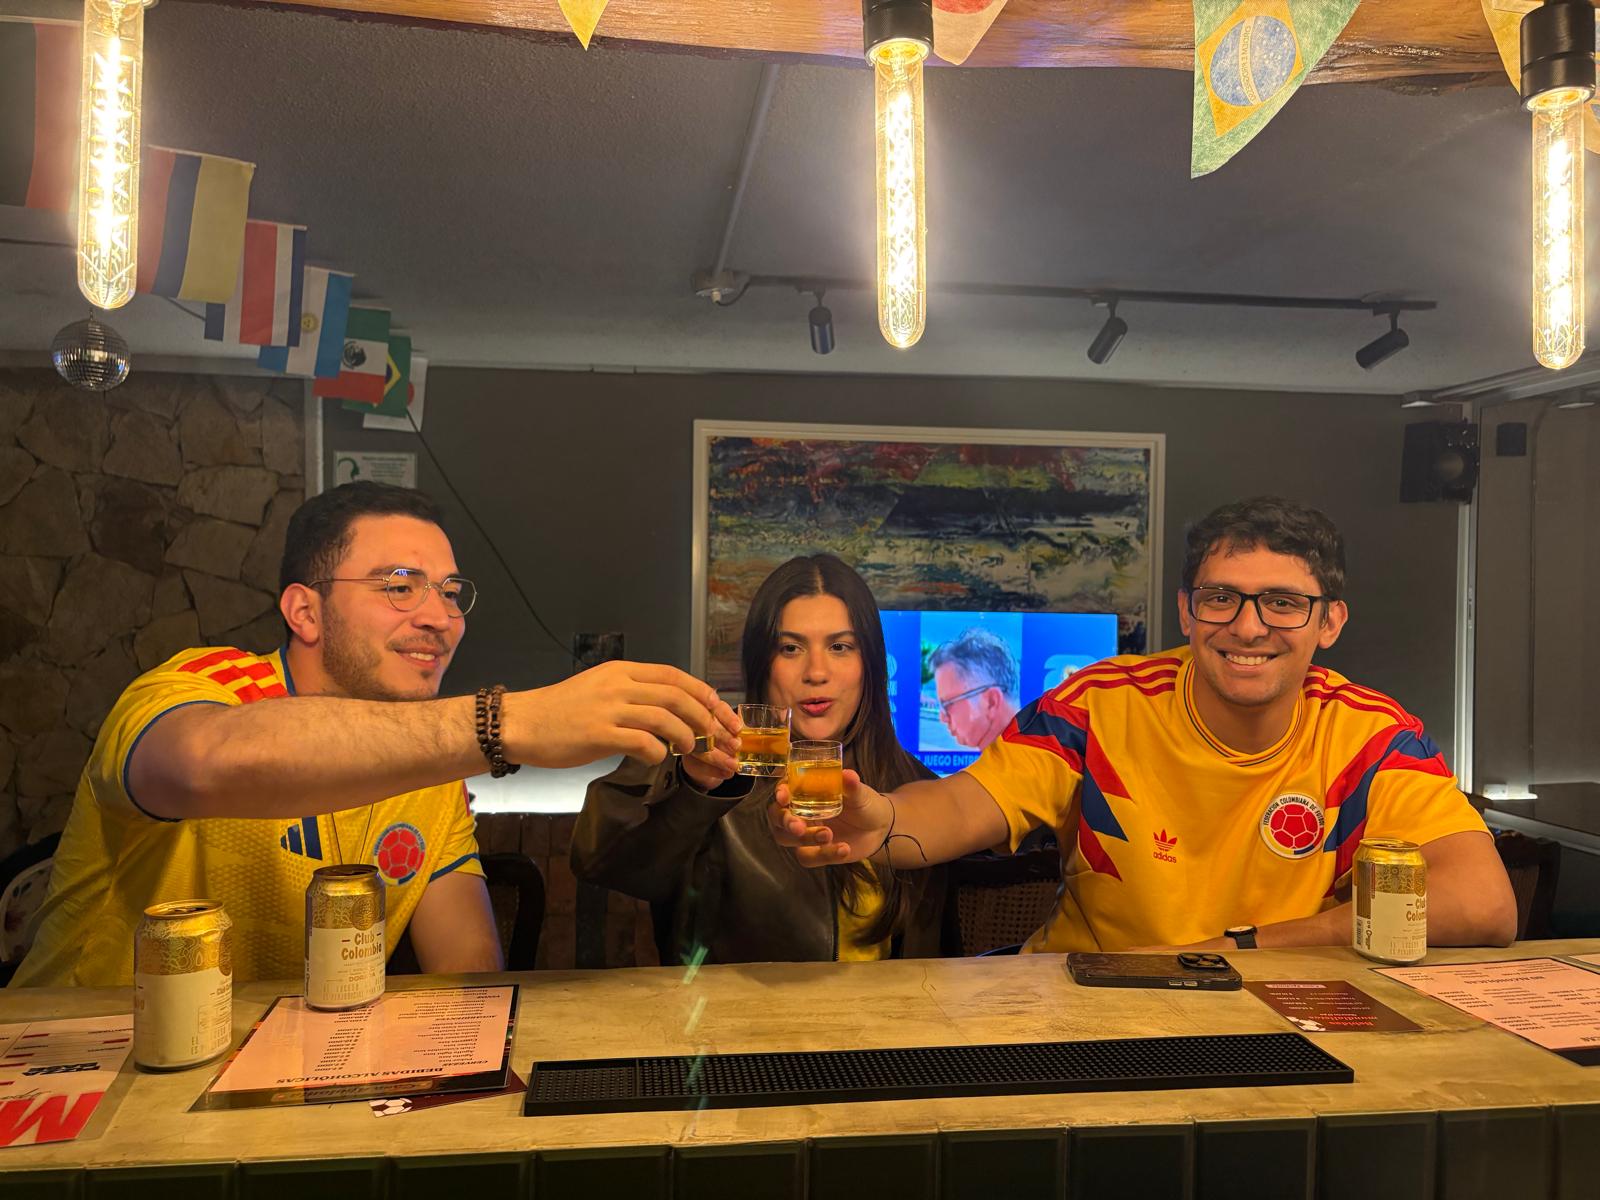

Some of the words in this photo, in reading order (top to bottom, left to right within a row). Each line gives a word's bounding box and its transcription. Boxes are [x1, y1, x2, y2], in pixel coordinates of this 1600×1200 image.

[924, 754, 952, 767] JUEGO
[1280, 795, 1310, 806] COLOMBIANA
[1309, 803, 1317, 812] DE
[1153, 851, 1177, 864] adidas
[354, 932, 375, 946] Club
[383, 1067, 443, 1076] BEBIDAS
